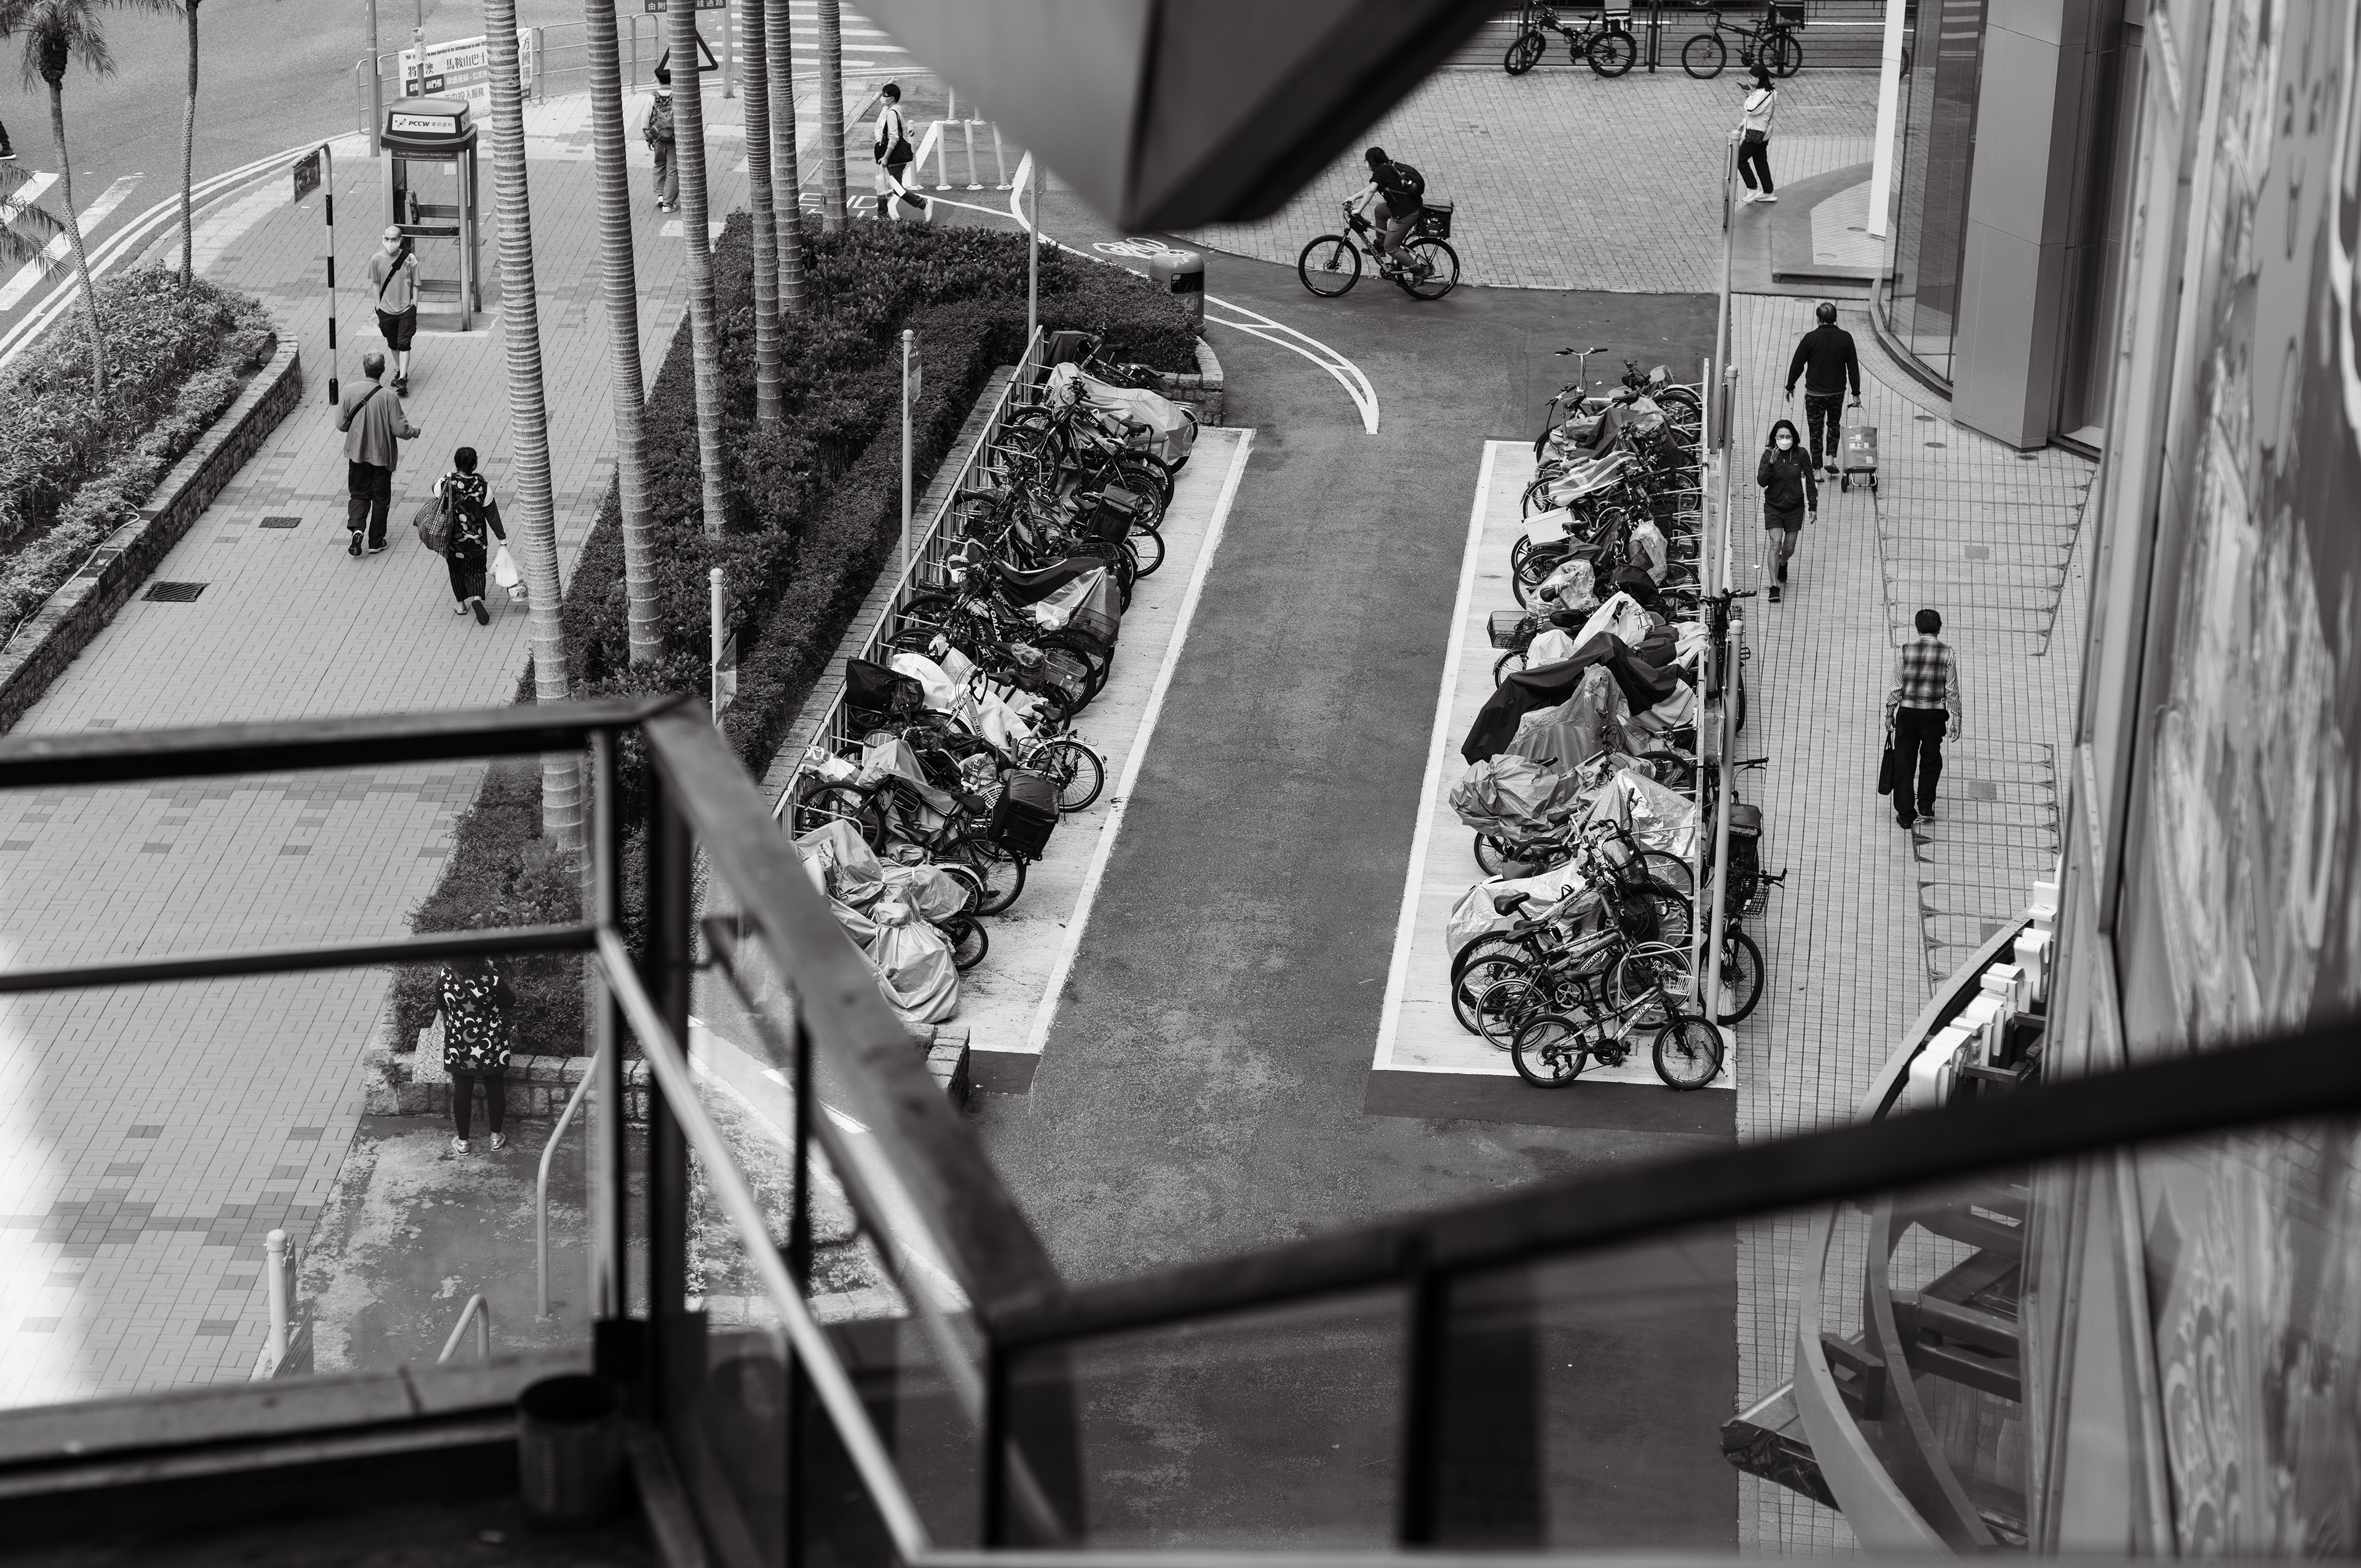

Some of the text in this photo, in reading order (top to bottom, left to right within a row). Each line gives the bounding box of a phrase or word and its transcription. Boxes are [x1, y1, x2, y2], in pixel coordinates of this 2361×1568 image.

[408, 63, 434, 77] 將澳
[1360, 234, 1384, 264] ROCKRIDER
[1589, 937, 1613, 954] TRINX
[1621, 1005, 1646, 1032] SOLAR
